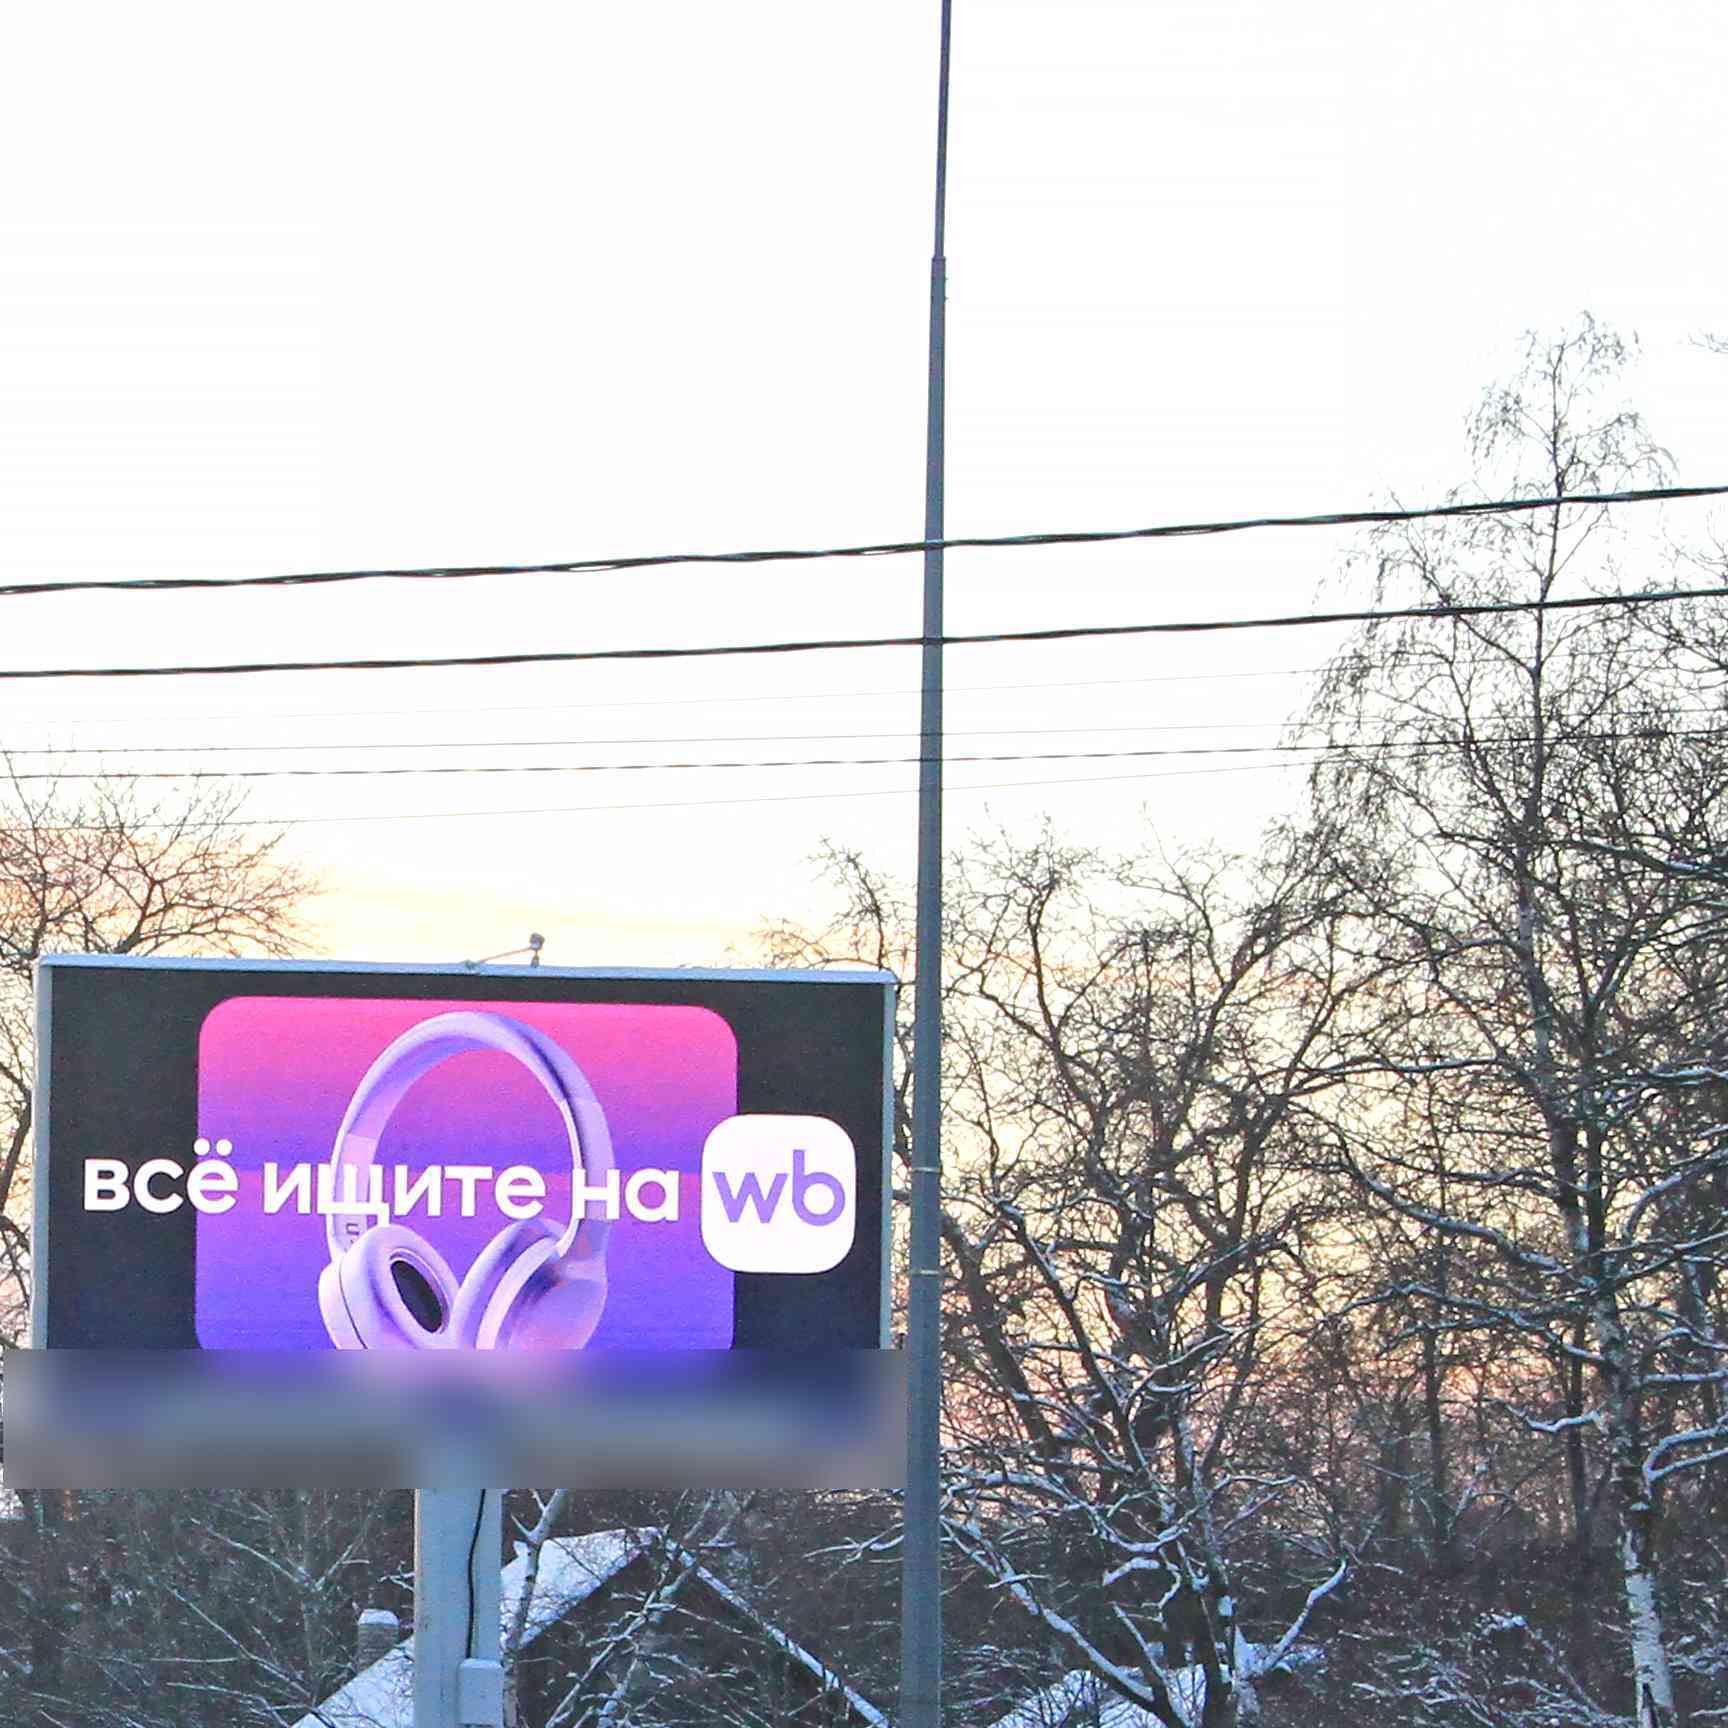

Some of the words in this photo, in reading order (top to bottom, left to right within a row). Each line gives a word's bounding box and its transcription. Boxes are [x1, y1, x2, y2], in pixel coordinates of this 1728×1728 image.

[83, 1136, 239, 1215] всё
[261, 1161, 548, 1228] ищите
[572, 1165, 680, 1223] на
[712, 1148, 847, 1227] wb
